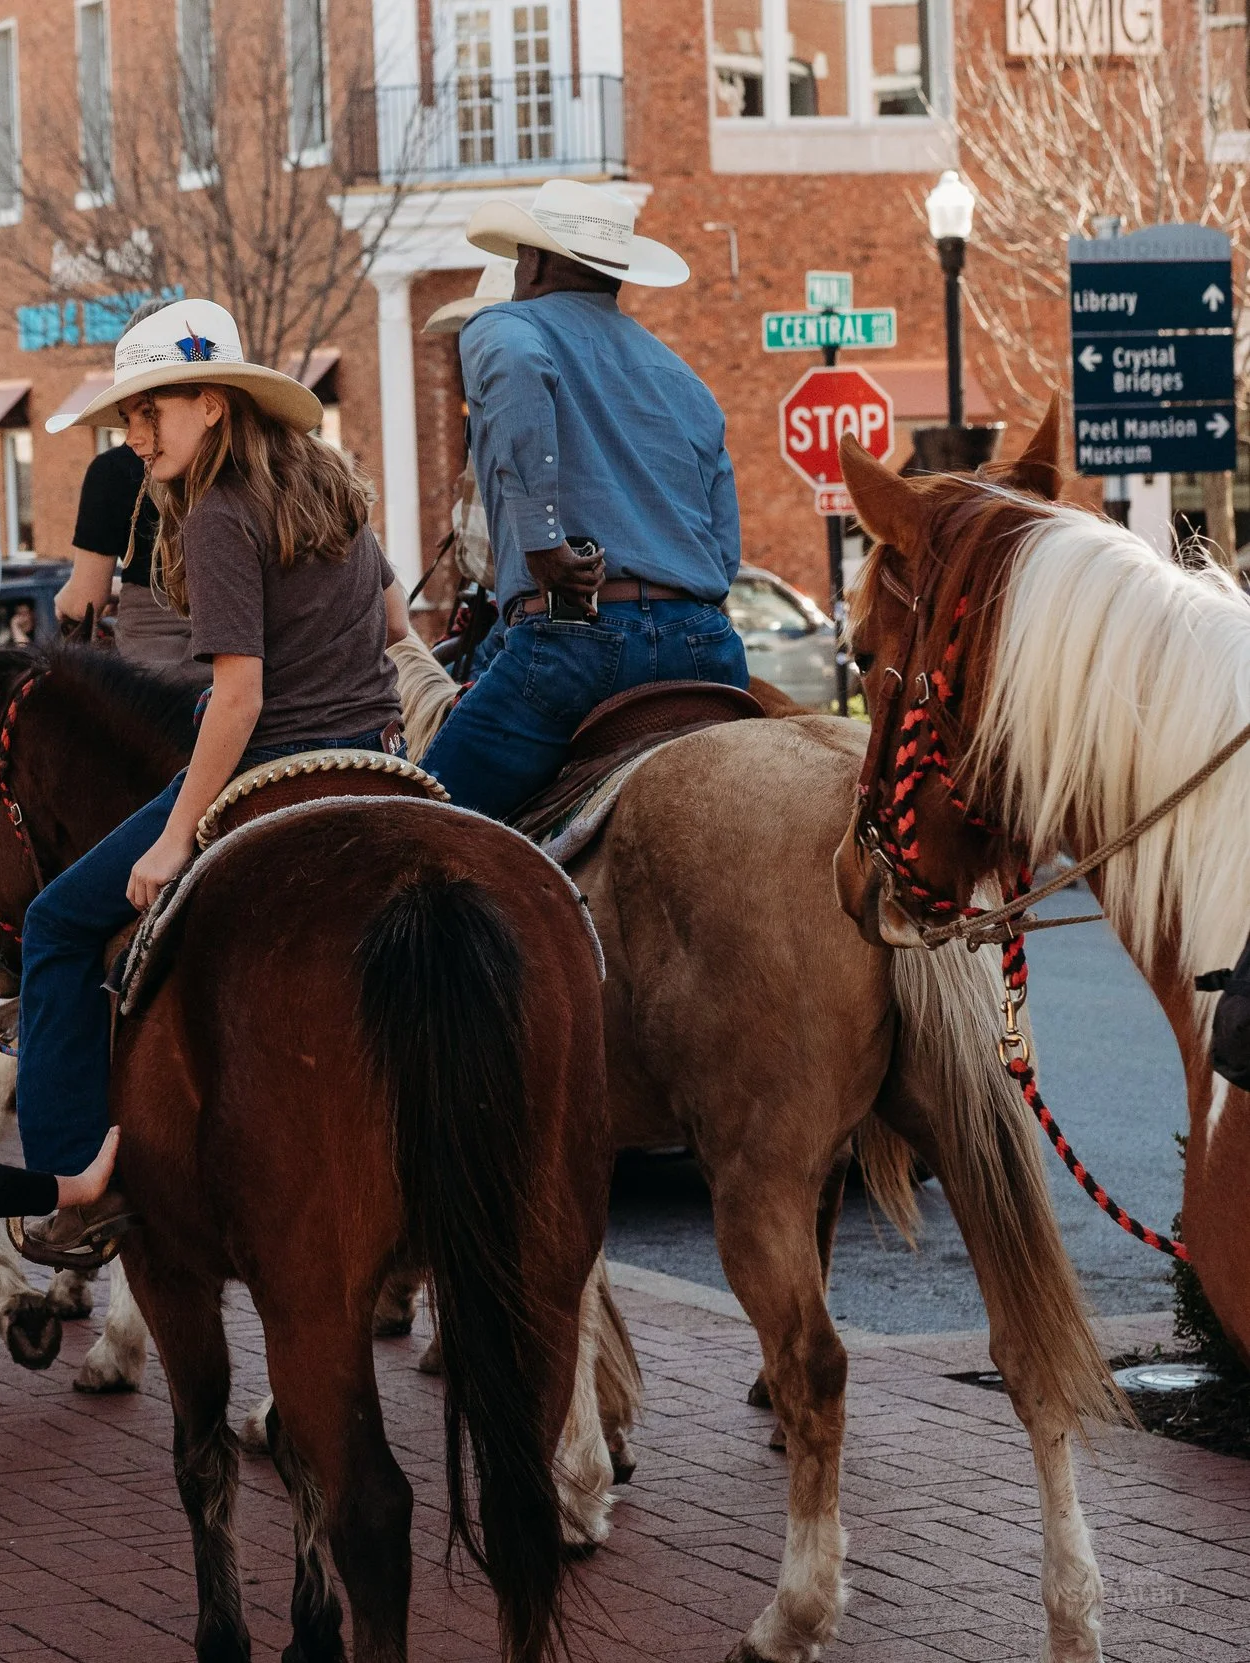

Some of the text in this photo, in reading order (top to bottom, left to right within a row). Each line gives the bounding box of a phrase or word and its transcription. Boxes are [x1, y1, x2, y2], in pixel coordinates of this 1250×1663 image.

[1016, 0, 1156, 45] KMG
[1073, 289, 1138, 316] Library
[781, 316, 867, 345] CENTRAL
[1112, 344, 1176, 373] Crystal
[1112, 369, 1184, 396] Bridges
[789, 403, 886, 452] STOP
[1078, 415, 1198, 441] Peel Mansion
[1079, 444, 1152, 466] Museum
